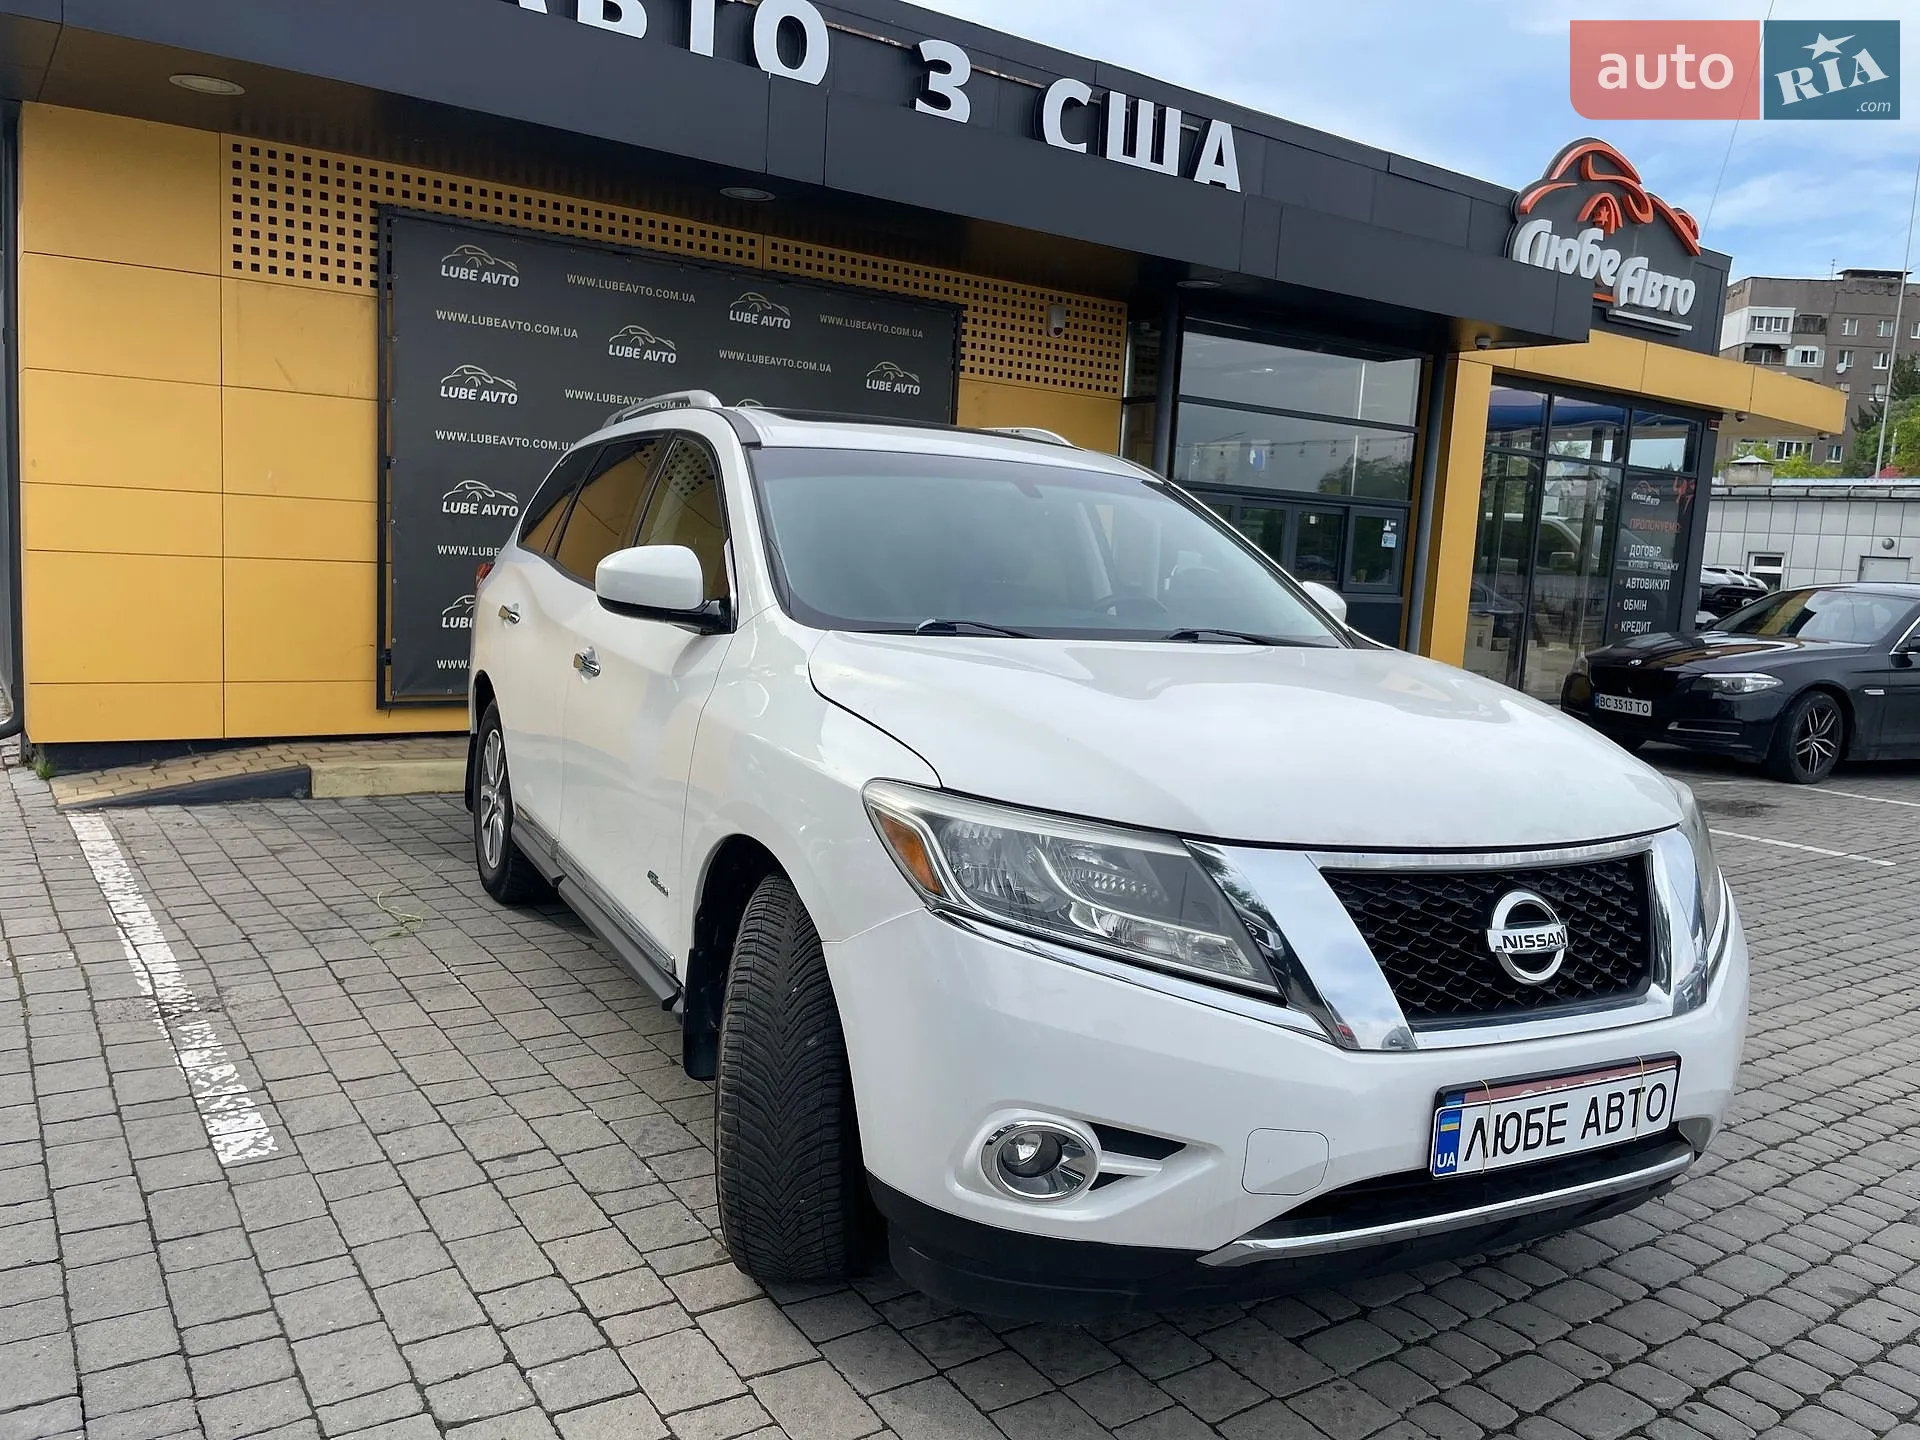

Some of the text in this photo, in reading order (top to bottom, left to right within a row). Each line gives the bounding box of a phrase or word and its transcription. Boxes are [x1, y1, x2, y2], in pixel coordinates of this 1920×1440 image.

[1043, 78, 1241, 193] США
[440, 264, 520, 288] LUBE AVTO
[566, 273, 696, 303] WWW.LUBEAVTO.COM.UA
[436, 310, 579, 339] WWW.LUBEAVTO.COM.UA
[729, 309, 791, 329] LUBE AVTO
[819, 314, 924, 339] WWW.LUBEAVTO.COM.UA
[608, 344, 677, 364] LUBE AVTO
[719, 349, 832, 373] WWW.LUBEAVTO.COM.UA
[440, 385, 518, 405] LUBE AVTO
[865, 379, 921, 395] LUBE AVTO
[442, 501, 519, 517] LUBE AVTO
[1625, 577, 1670, 590] АВТОВИКУП
[1623, 599, 1647, 611] ОБМІН
[1620, 620, 1652, 634] КРЕДИТ
[1613, 699, 1633, 711] 3513
[1502, 930, 1566, 950] NISSAN
[1464, 1082, 1668, 1162] ЛЮБЕ АВТО
[1437, 1152, 1457, 1169] UA
